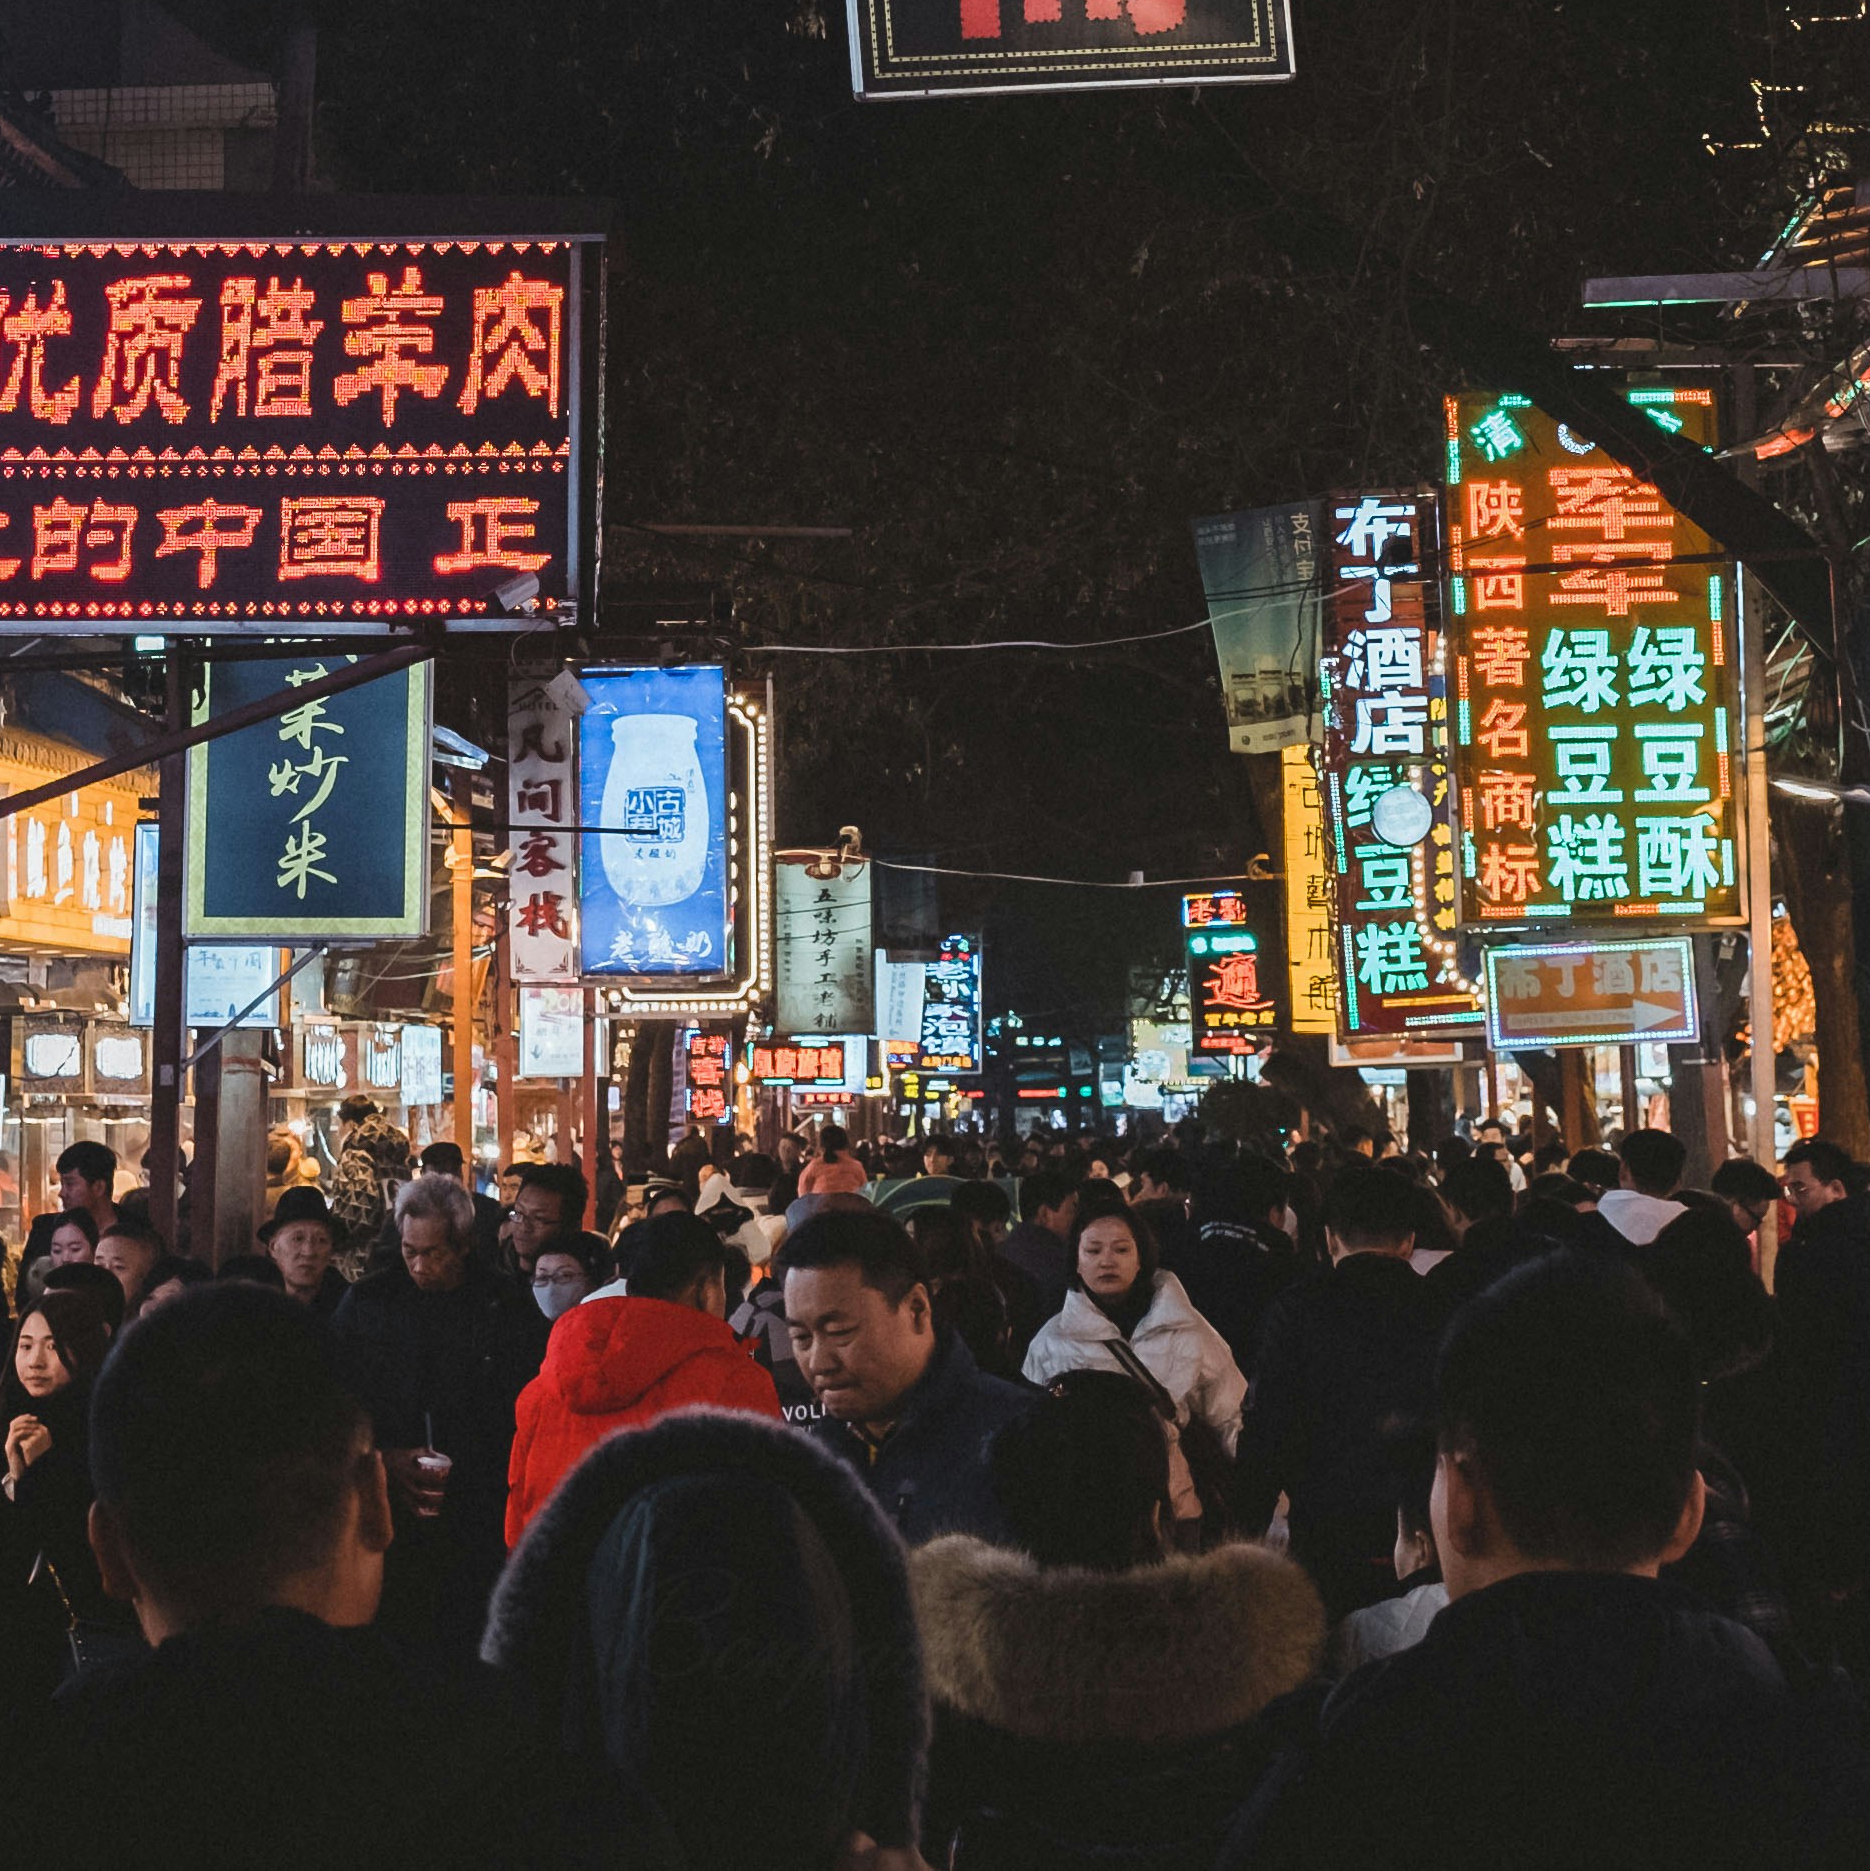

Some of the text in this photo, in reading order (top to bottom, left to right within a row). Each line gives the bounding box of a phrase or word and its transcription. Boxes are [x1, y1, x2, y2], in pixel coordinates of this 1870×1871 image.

[1470, 409, 1524, 463] 清
[433, 496, 552, 575] 正
[1289, 512, 1316, 580] 支付宝
[1335, 496, 1428, 756] 布丁酒店
[1466, 478, 1544, 902] 陕西著名商标
[1540, 626, 1629, 902] 绿豆糕
[1626, 626, 1718, 902] 绿豆酥
[1497, 950, 1683, 999] 布丁酒店
